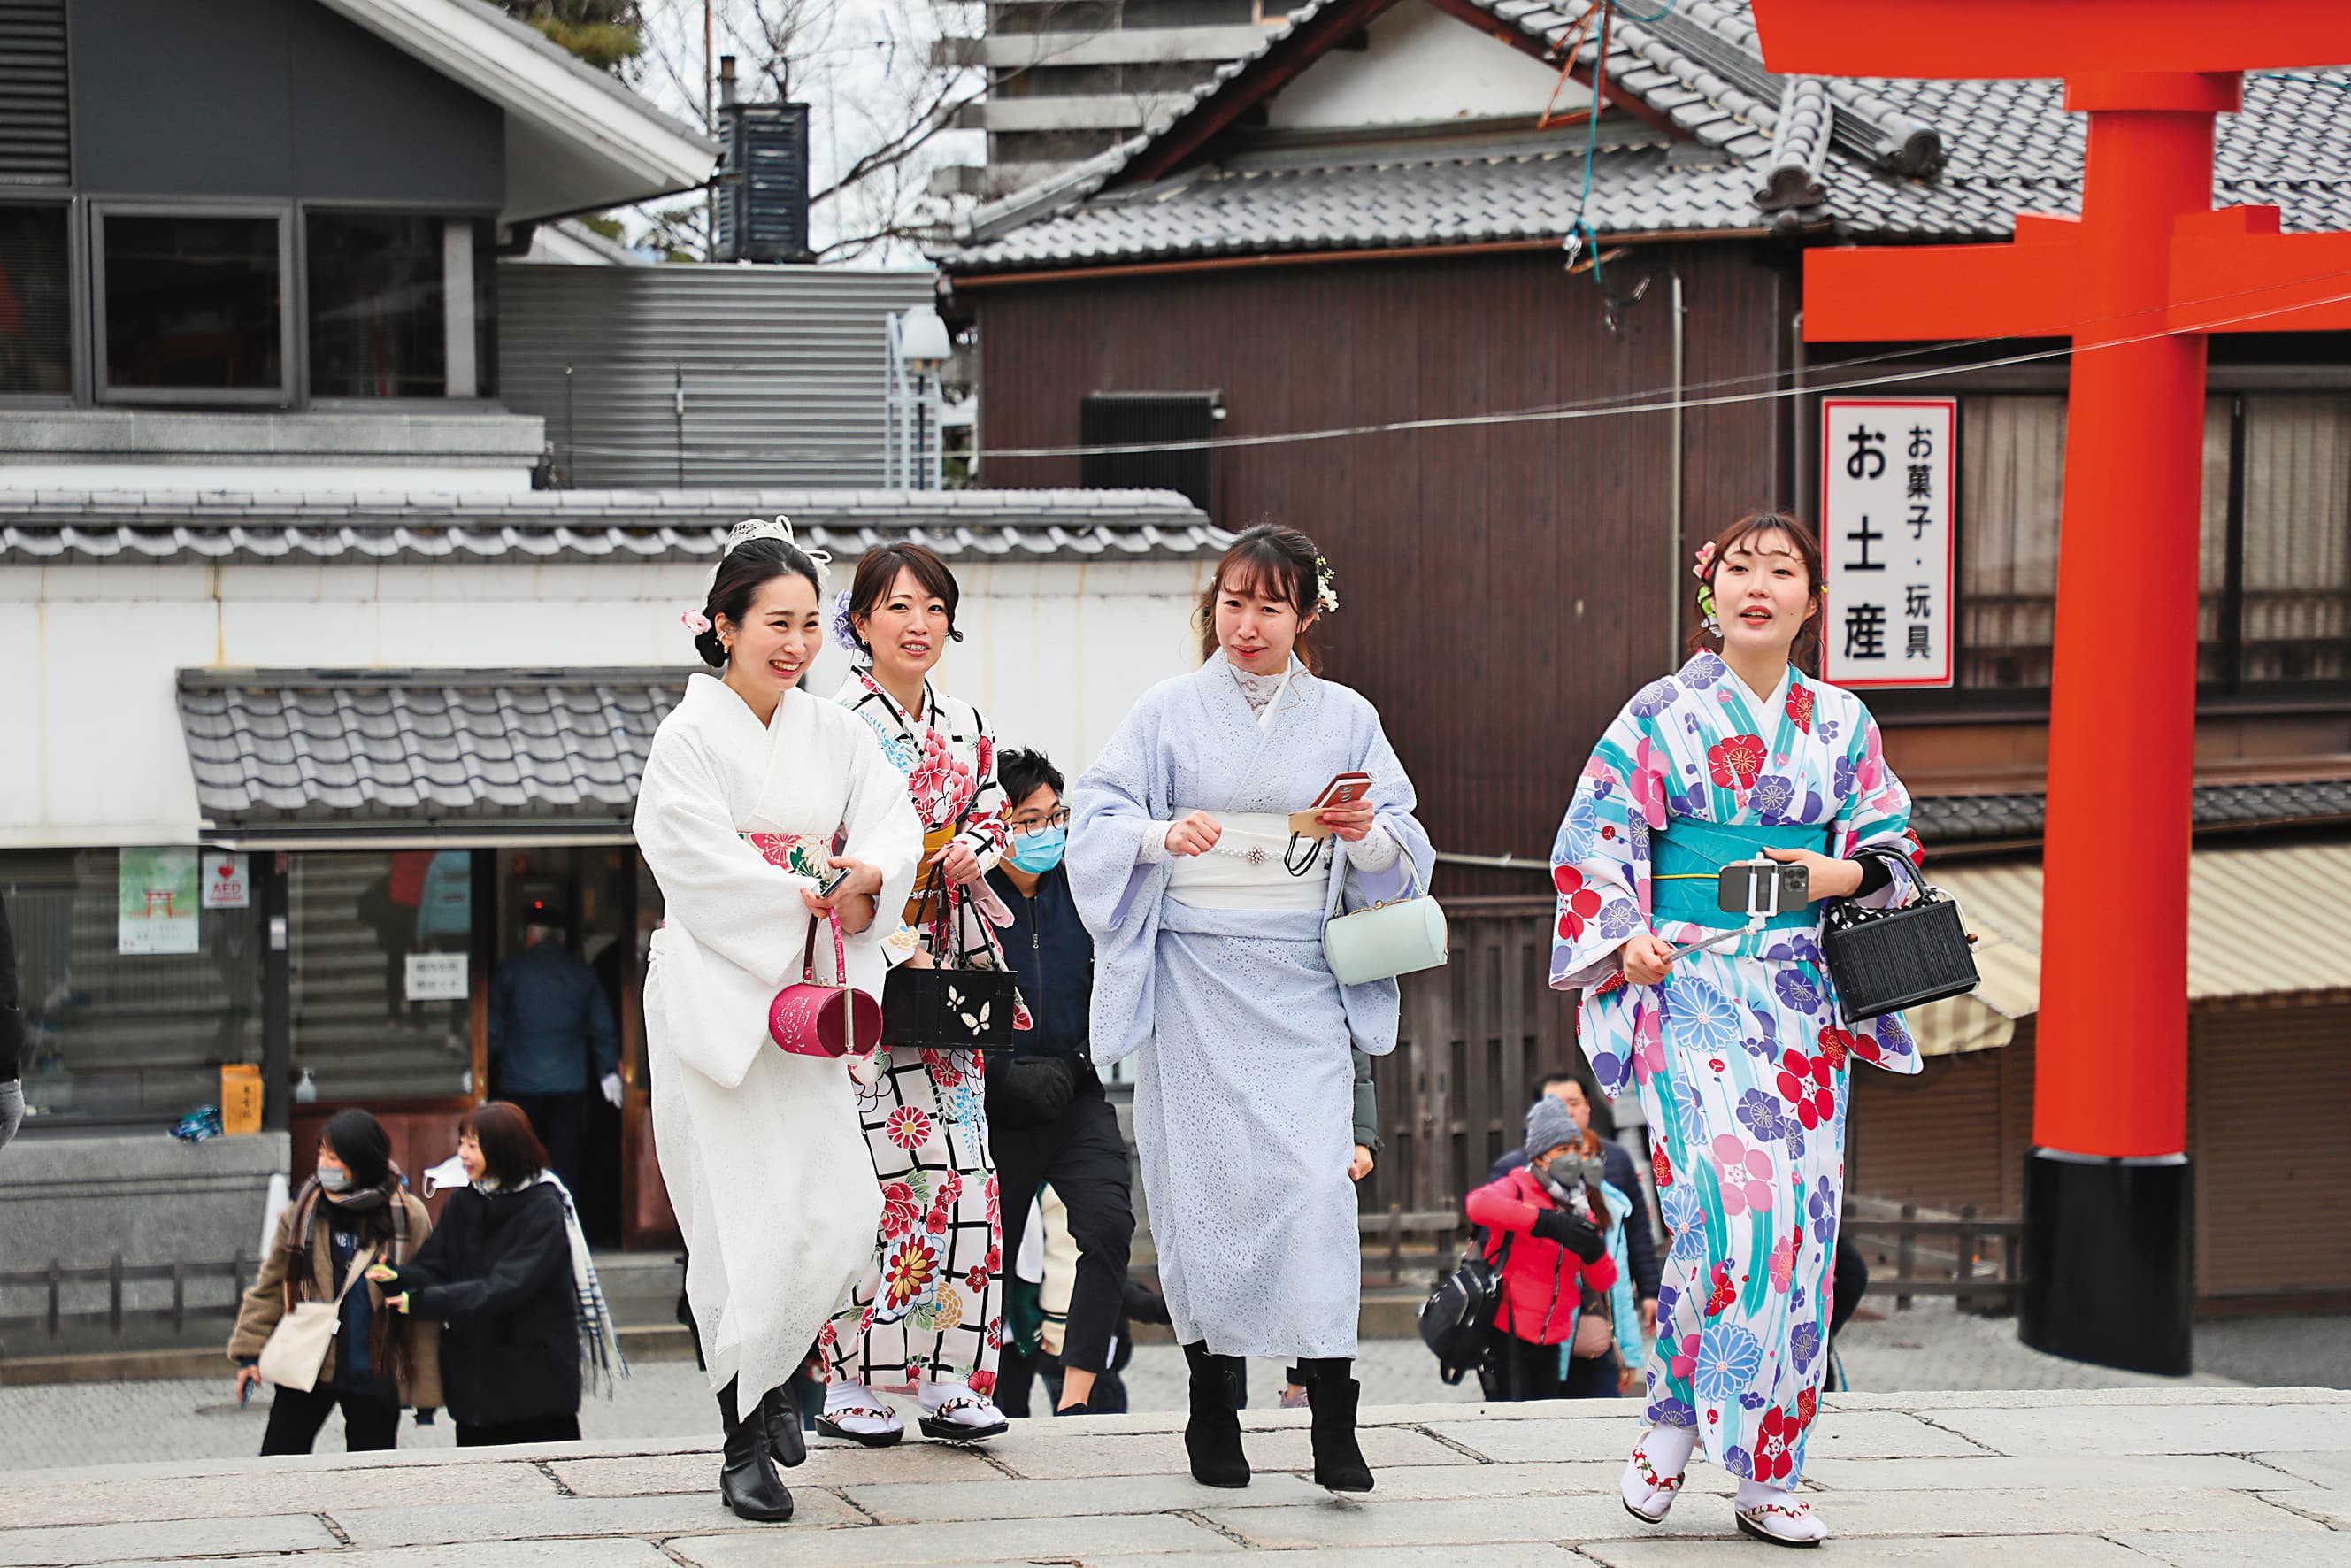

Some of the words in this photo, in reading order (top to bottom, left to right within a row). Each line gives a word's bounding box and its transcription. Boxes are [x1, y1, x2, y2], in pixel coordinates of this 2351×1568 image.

[1843, 424, 1887, 660] お土産
[1905, 424, 1932, 659] お菓子・玩具
[212, 882, 242, 894] AED
